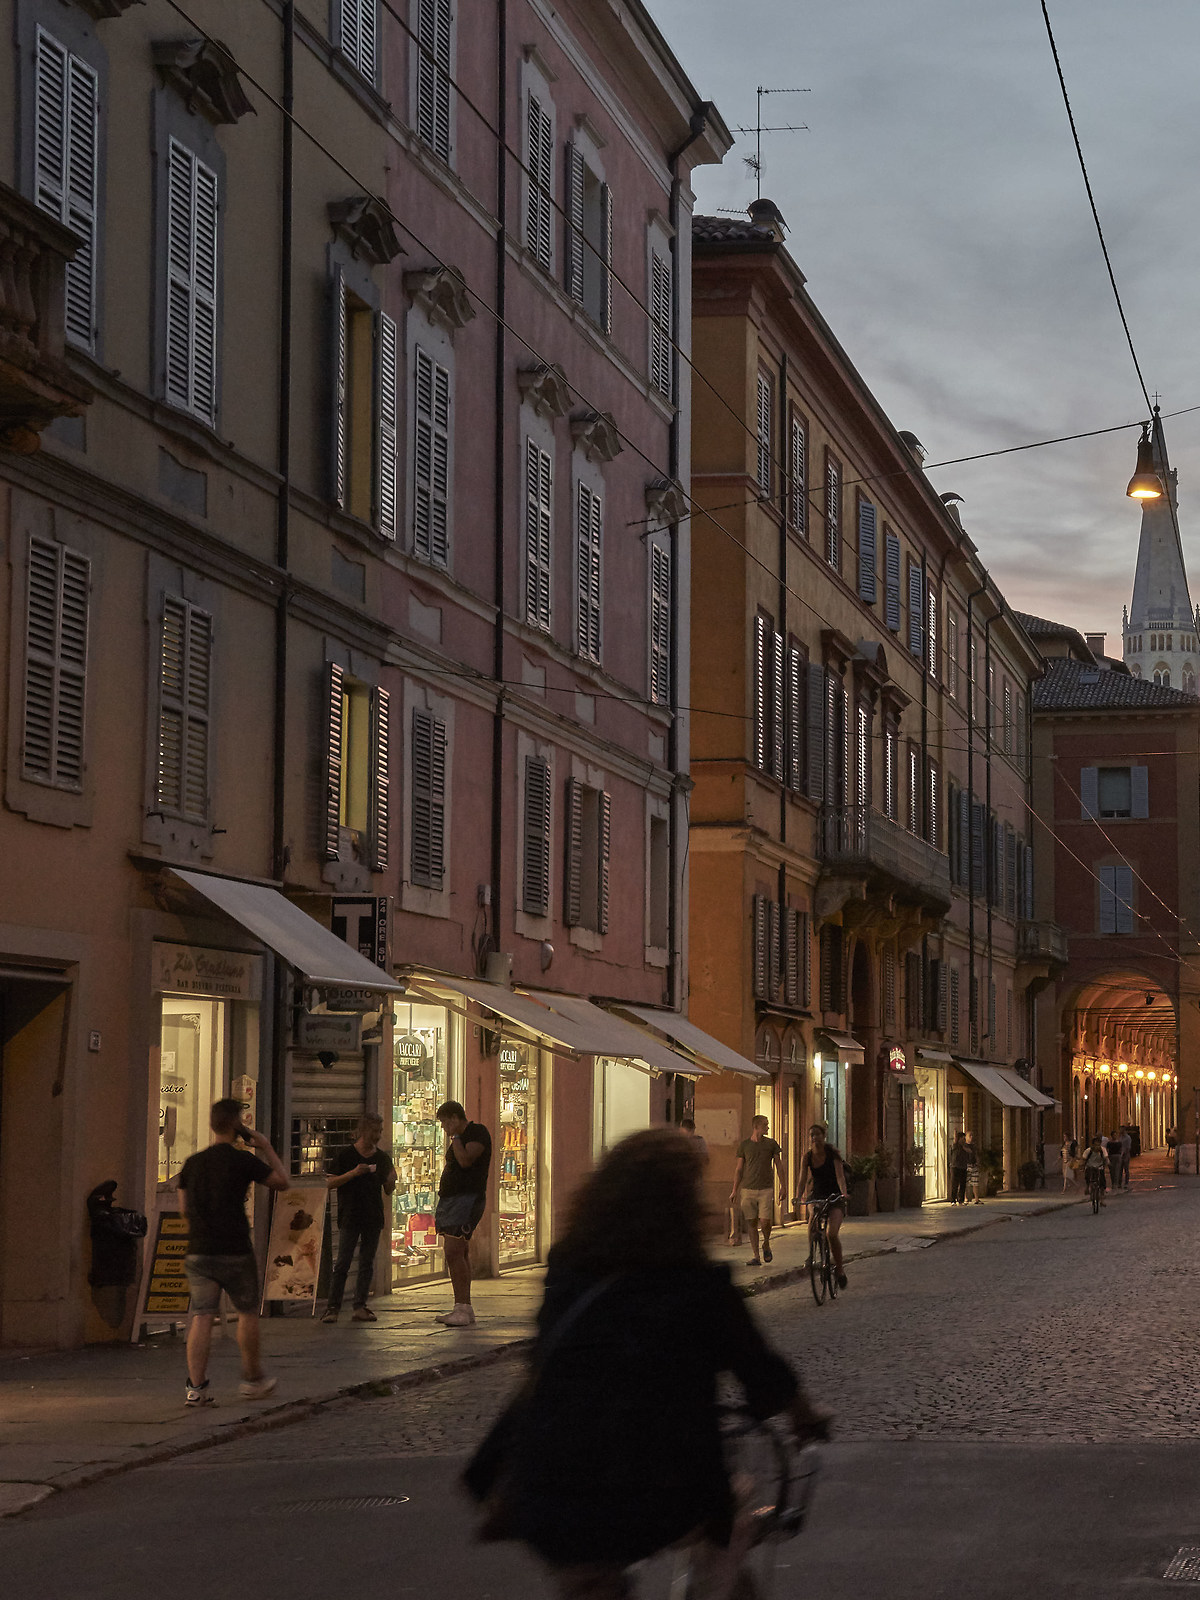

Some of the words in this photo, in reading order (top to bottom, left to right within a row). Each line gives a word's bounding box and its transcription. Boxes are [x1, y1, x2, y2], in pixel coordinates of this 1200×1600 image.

[380, 899, 386, 913] 24
[334, 904, 373, 953] T
[379, 919, 387, 941] ORE
[378, 947, 386, 962] SU
[340, 989, 372, 999] LOTTO
[399, 1042, 422, 1057] VACCARI
[500, 1049, 517, 1063] CCARI
